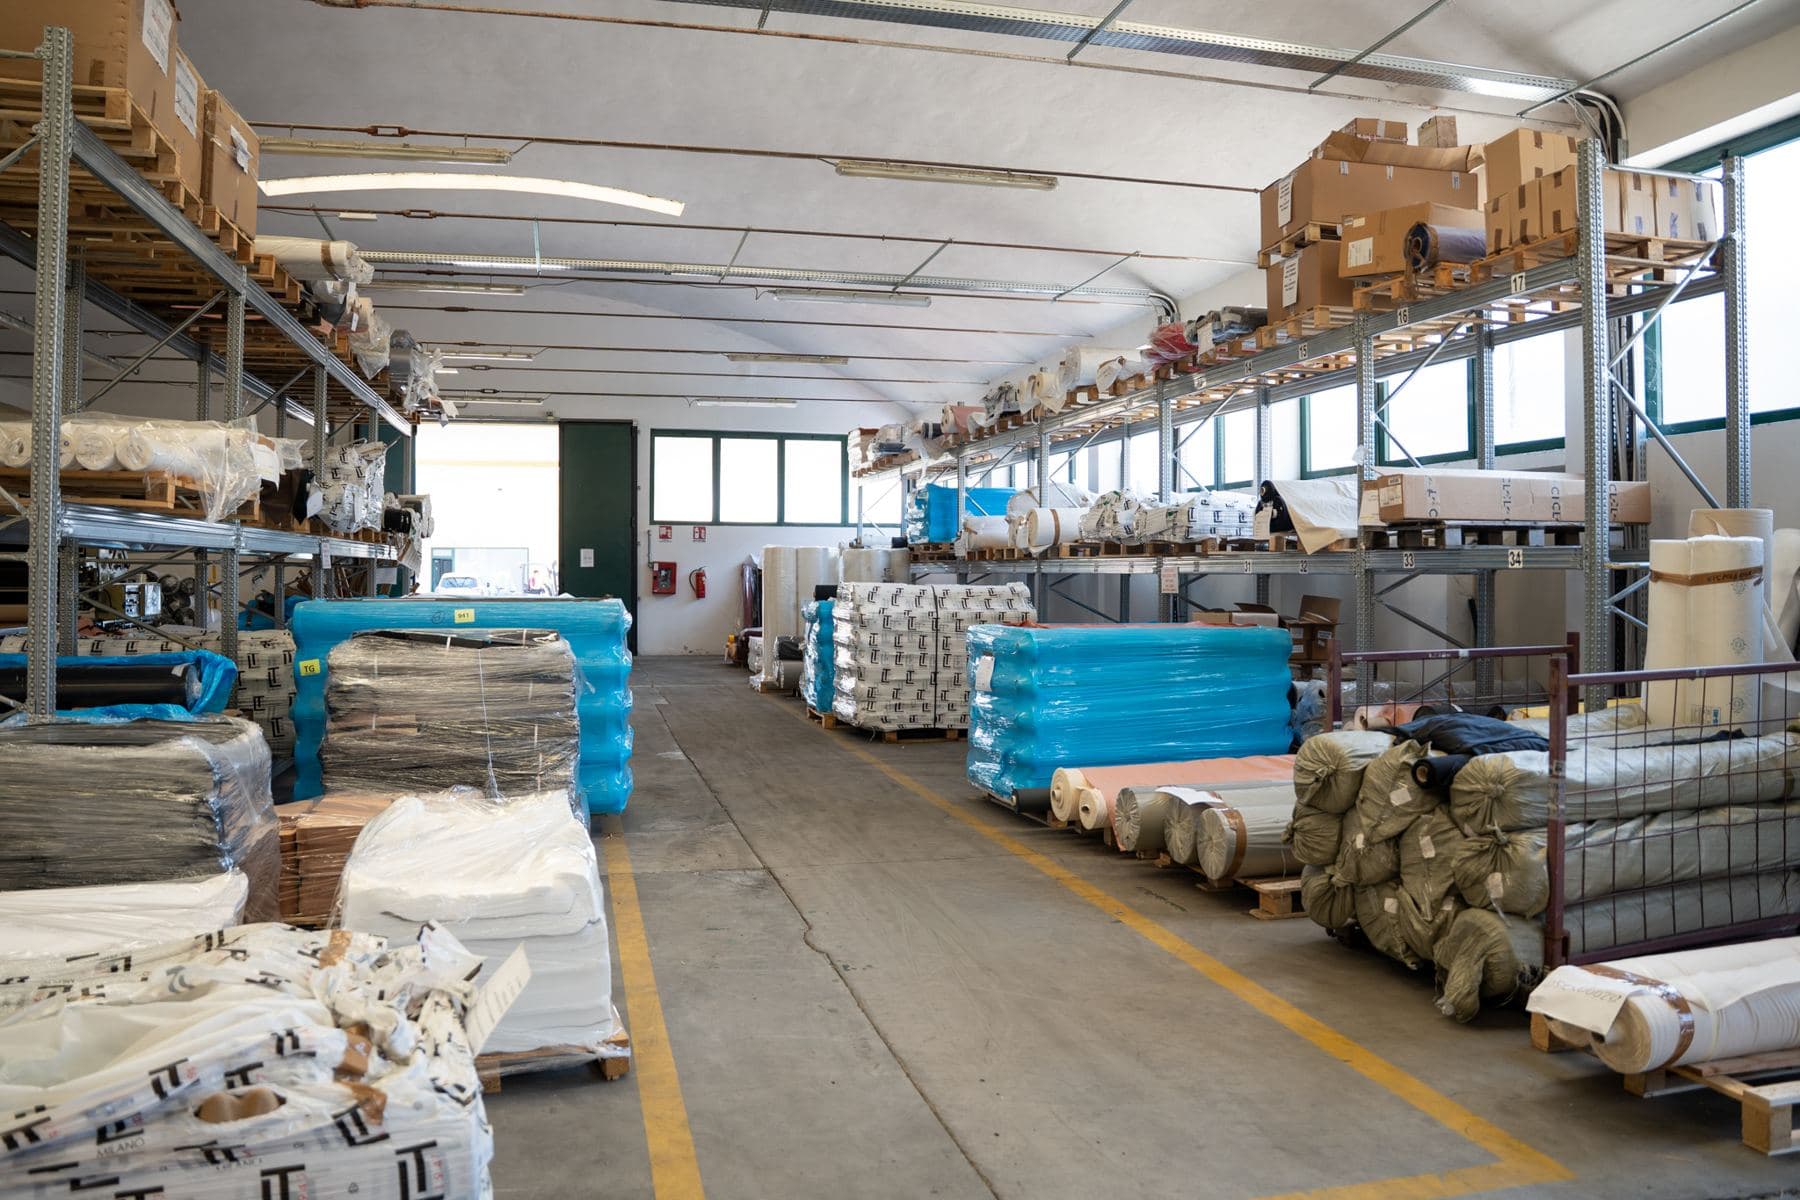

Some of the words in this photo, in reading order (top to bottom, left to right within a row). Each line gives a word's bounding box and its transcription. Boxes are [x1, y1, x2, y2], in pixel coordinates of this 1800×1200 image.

[1512, 276, 1524, 292] 17
[1399, 309, 1408, 324] 16
[1299, 345, 1308, 357] 15
[1404, 553, 1413, 567] 33
[1508, 551, 1521, 567] 34
[304, 664, 316, 673] TG
